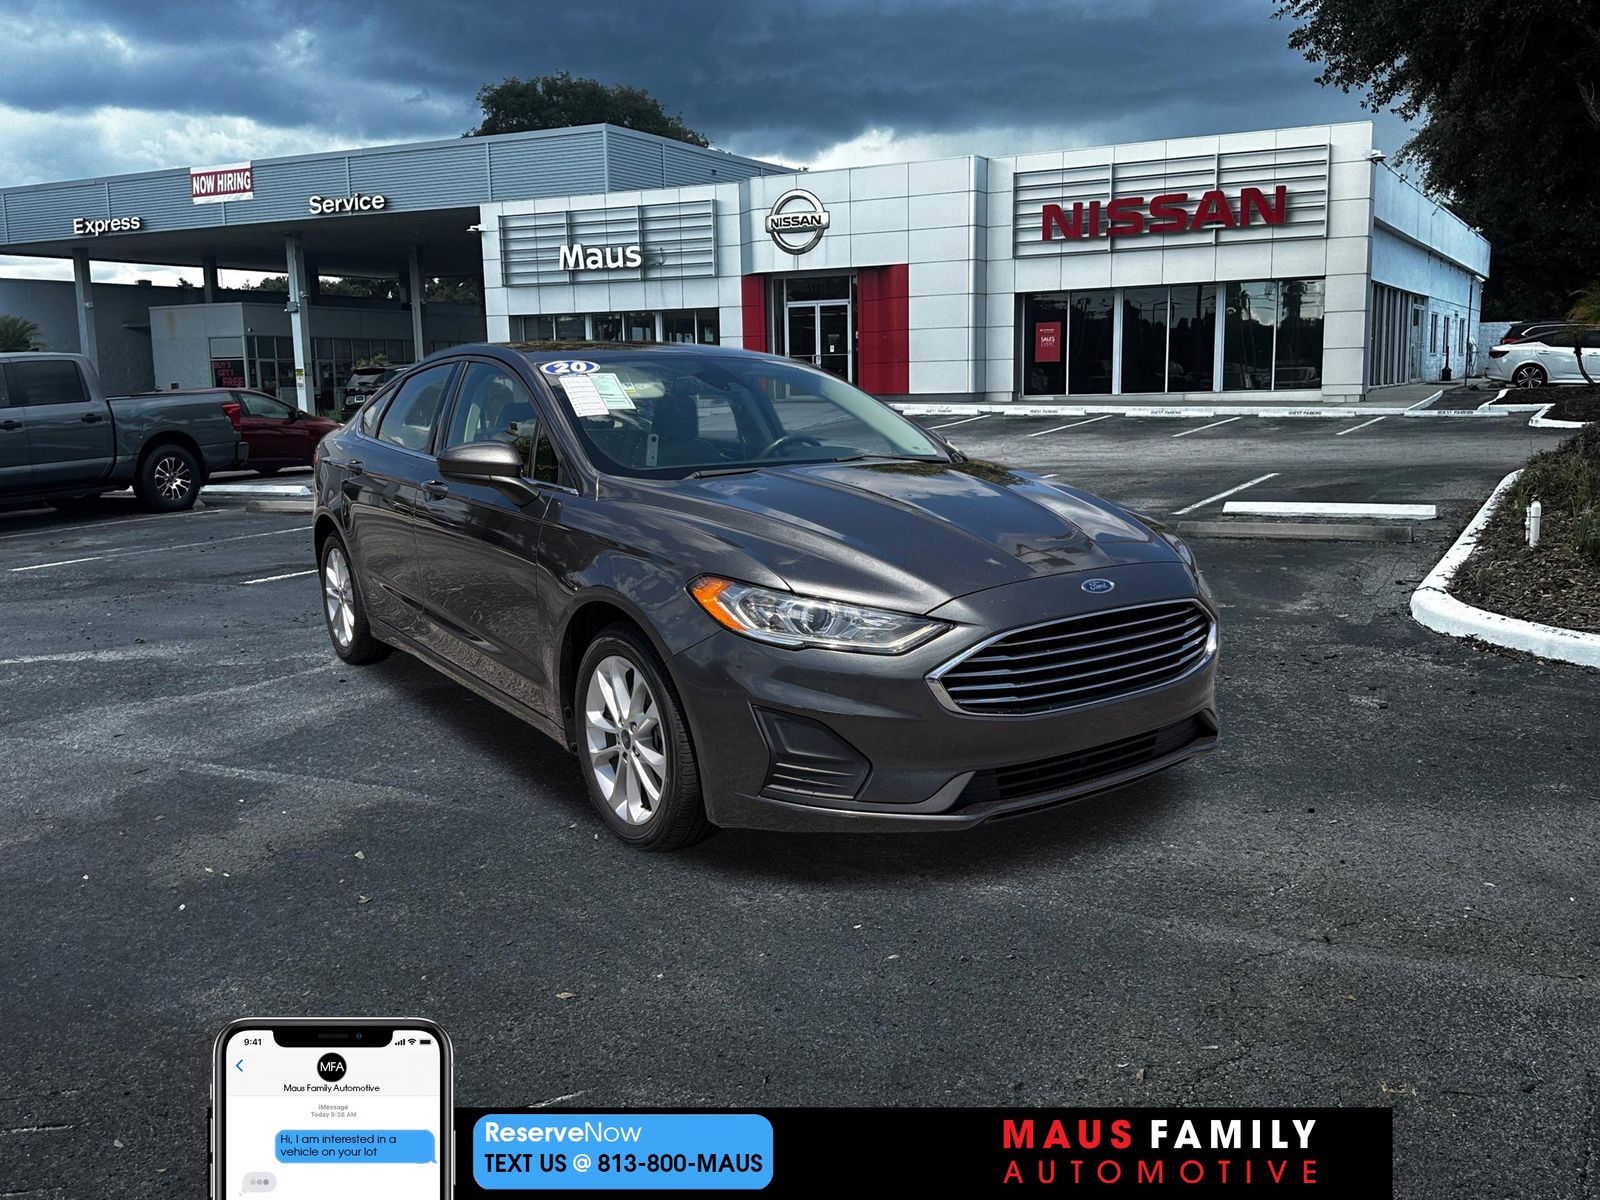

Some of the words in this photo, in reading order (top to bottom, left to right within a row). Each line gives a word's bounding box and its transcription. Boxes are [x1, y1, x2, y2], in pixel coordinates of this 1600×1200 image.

[192, 174, 215, 195] NOW
[217, 170, 251, 192] HIRING
[309, 192, 385, 214] Service
[1042, 185, 1287, 241] NISSAN
[73, 215, 141, 237] Express
[770, 214, 822, 229] NISSAN
[559, 243, 642, 271] Maus
[554, 362, 587, 373] 20
[223, 377, 244, 386] FREE
[1089, 581, 1108, 590] Ford
